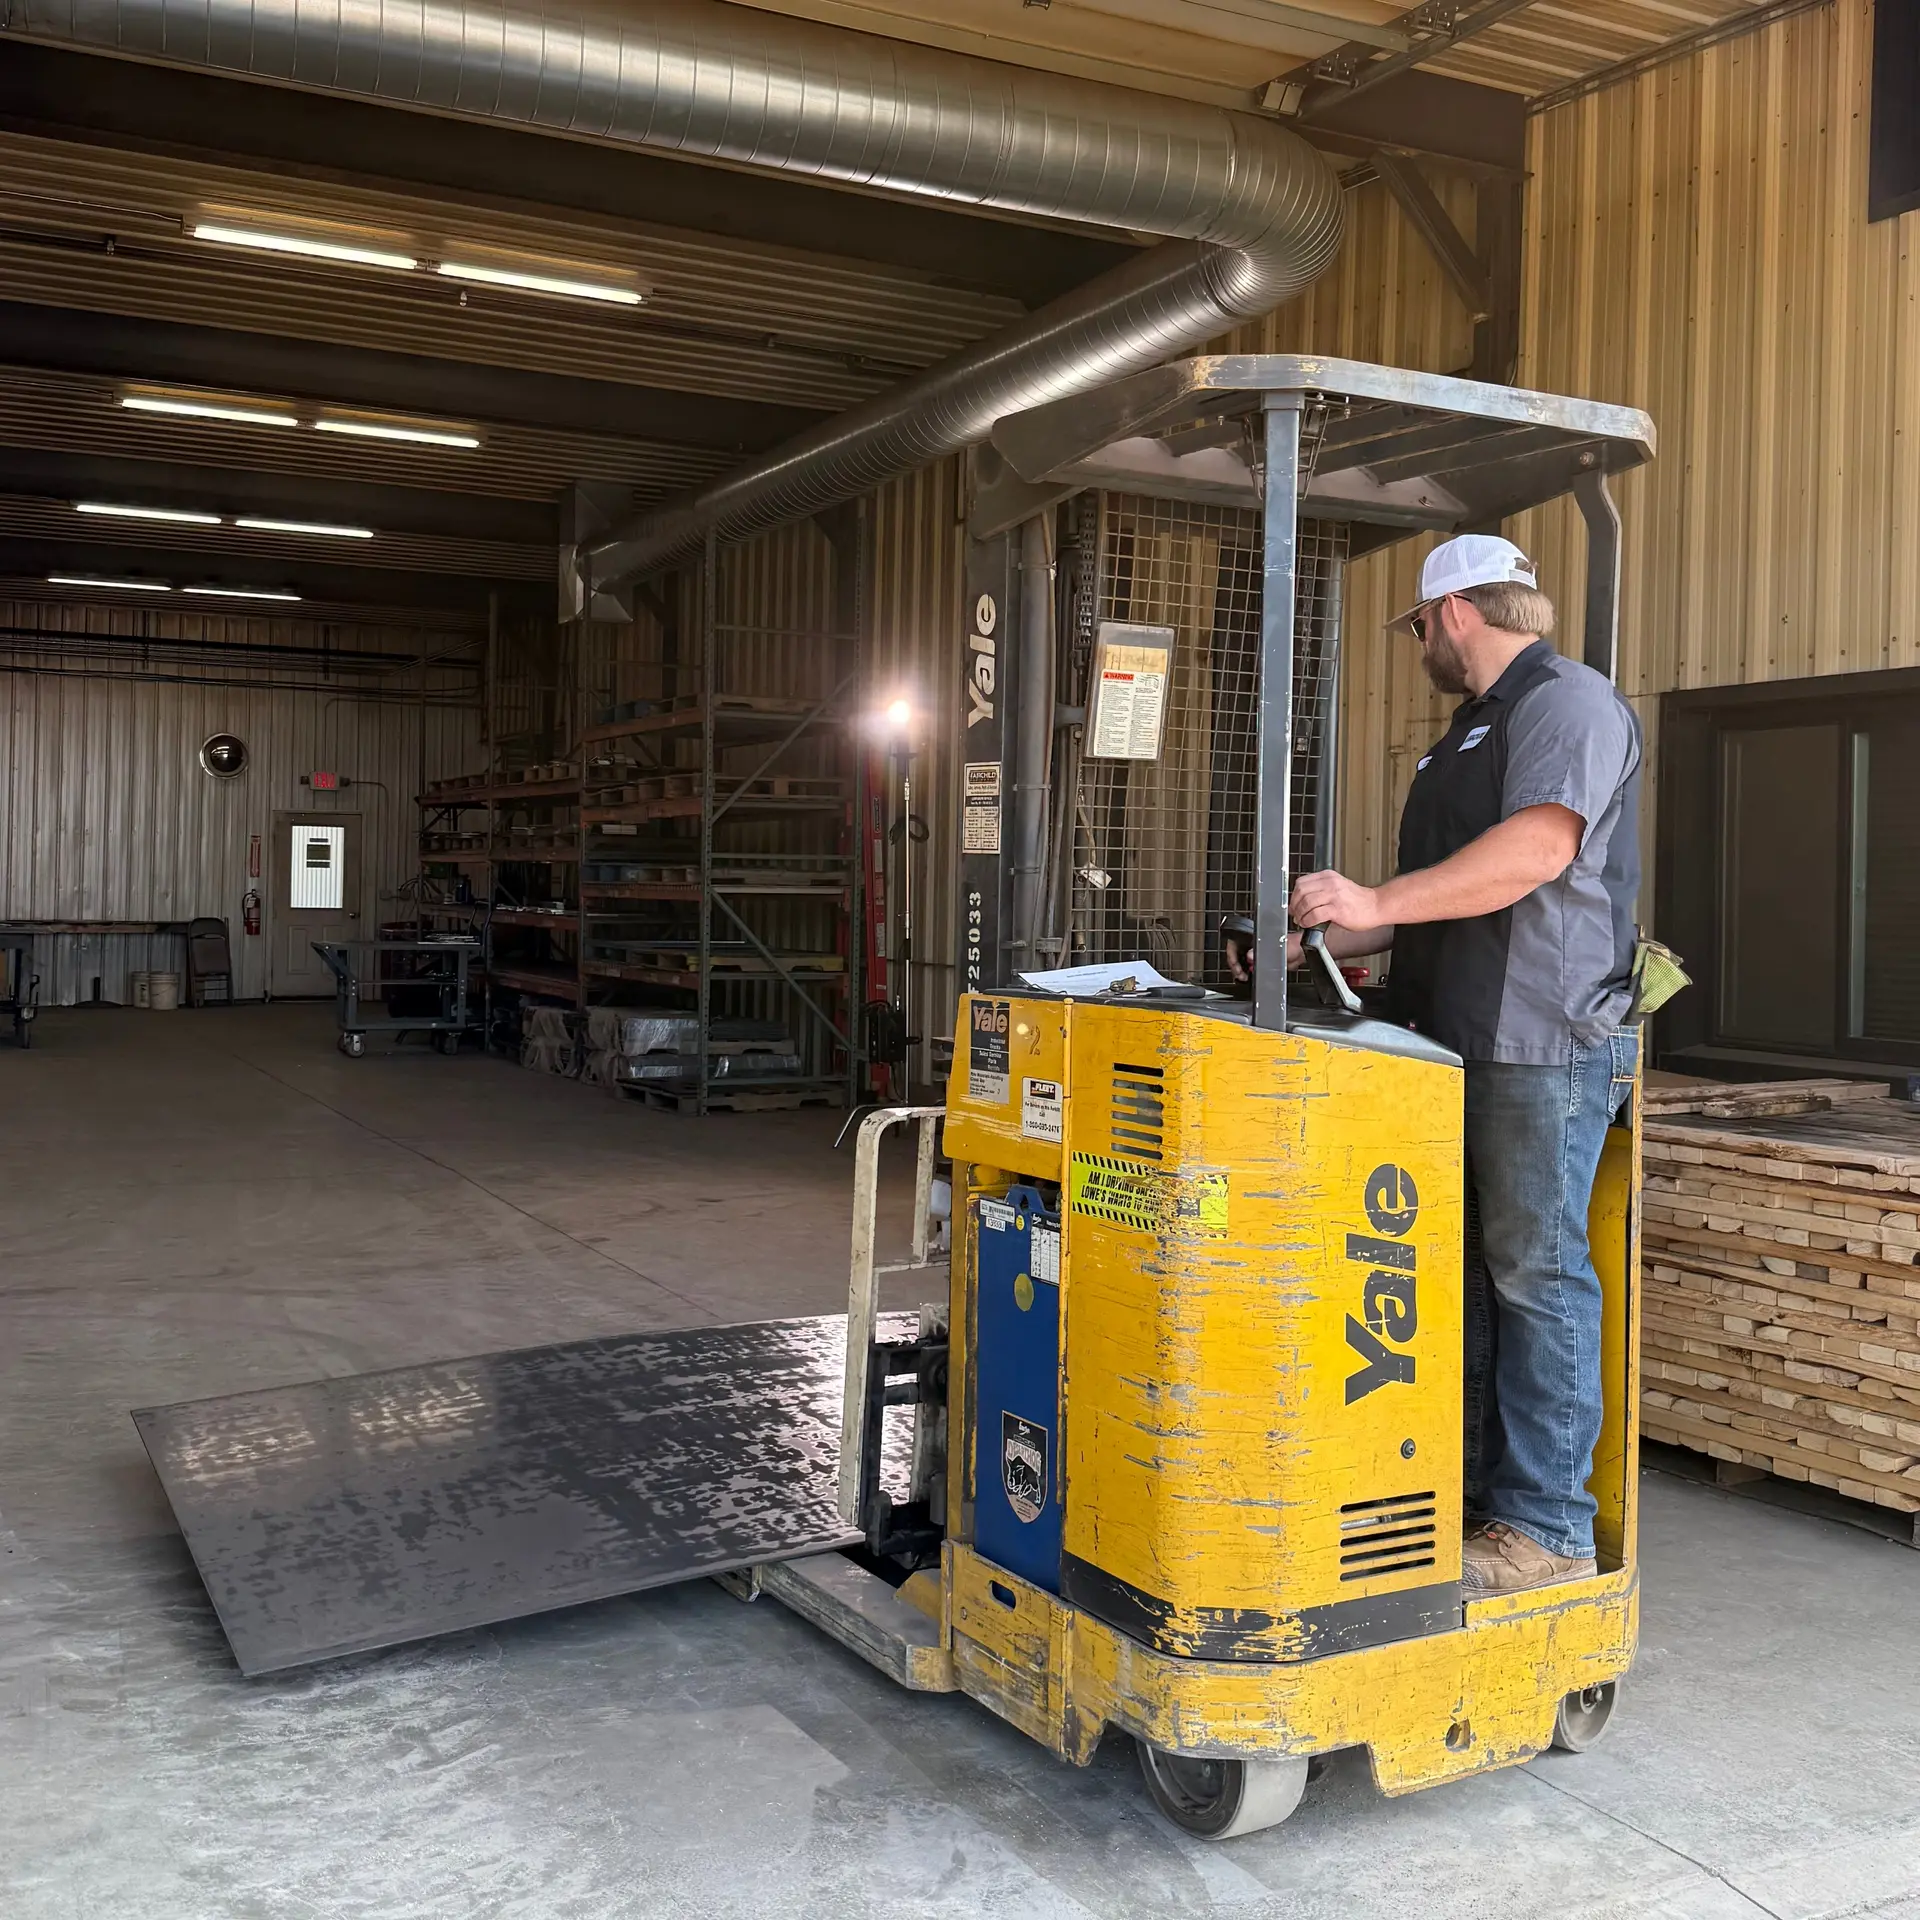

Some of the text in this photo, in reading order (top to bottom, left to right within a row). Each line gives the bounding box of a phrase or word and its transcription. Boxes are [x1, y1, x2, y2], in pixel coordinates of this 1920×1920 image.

[968, 594, 996, 728] Yale
[973, 1006, 1008, 1033] Yale
[1088, 1170, 1101, 1185] AM
[1081, 1184, 1107, 1203] LOWE'S
[1345, 1163, 1419, 1406] Yale
